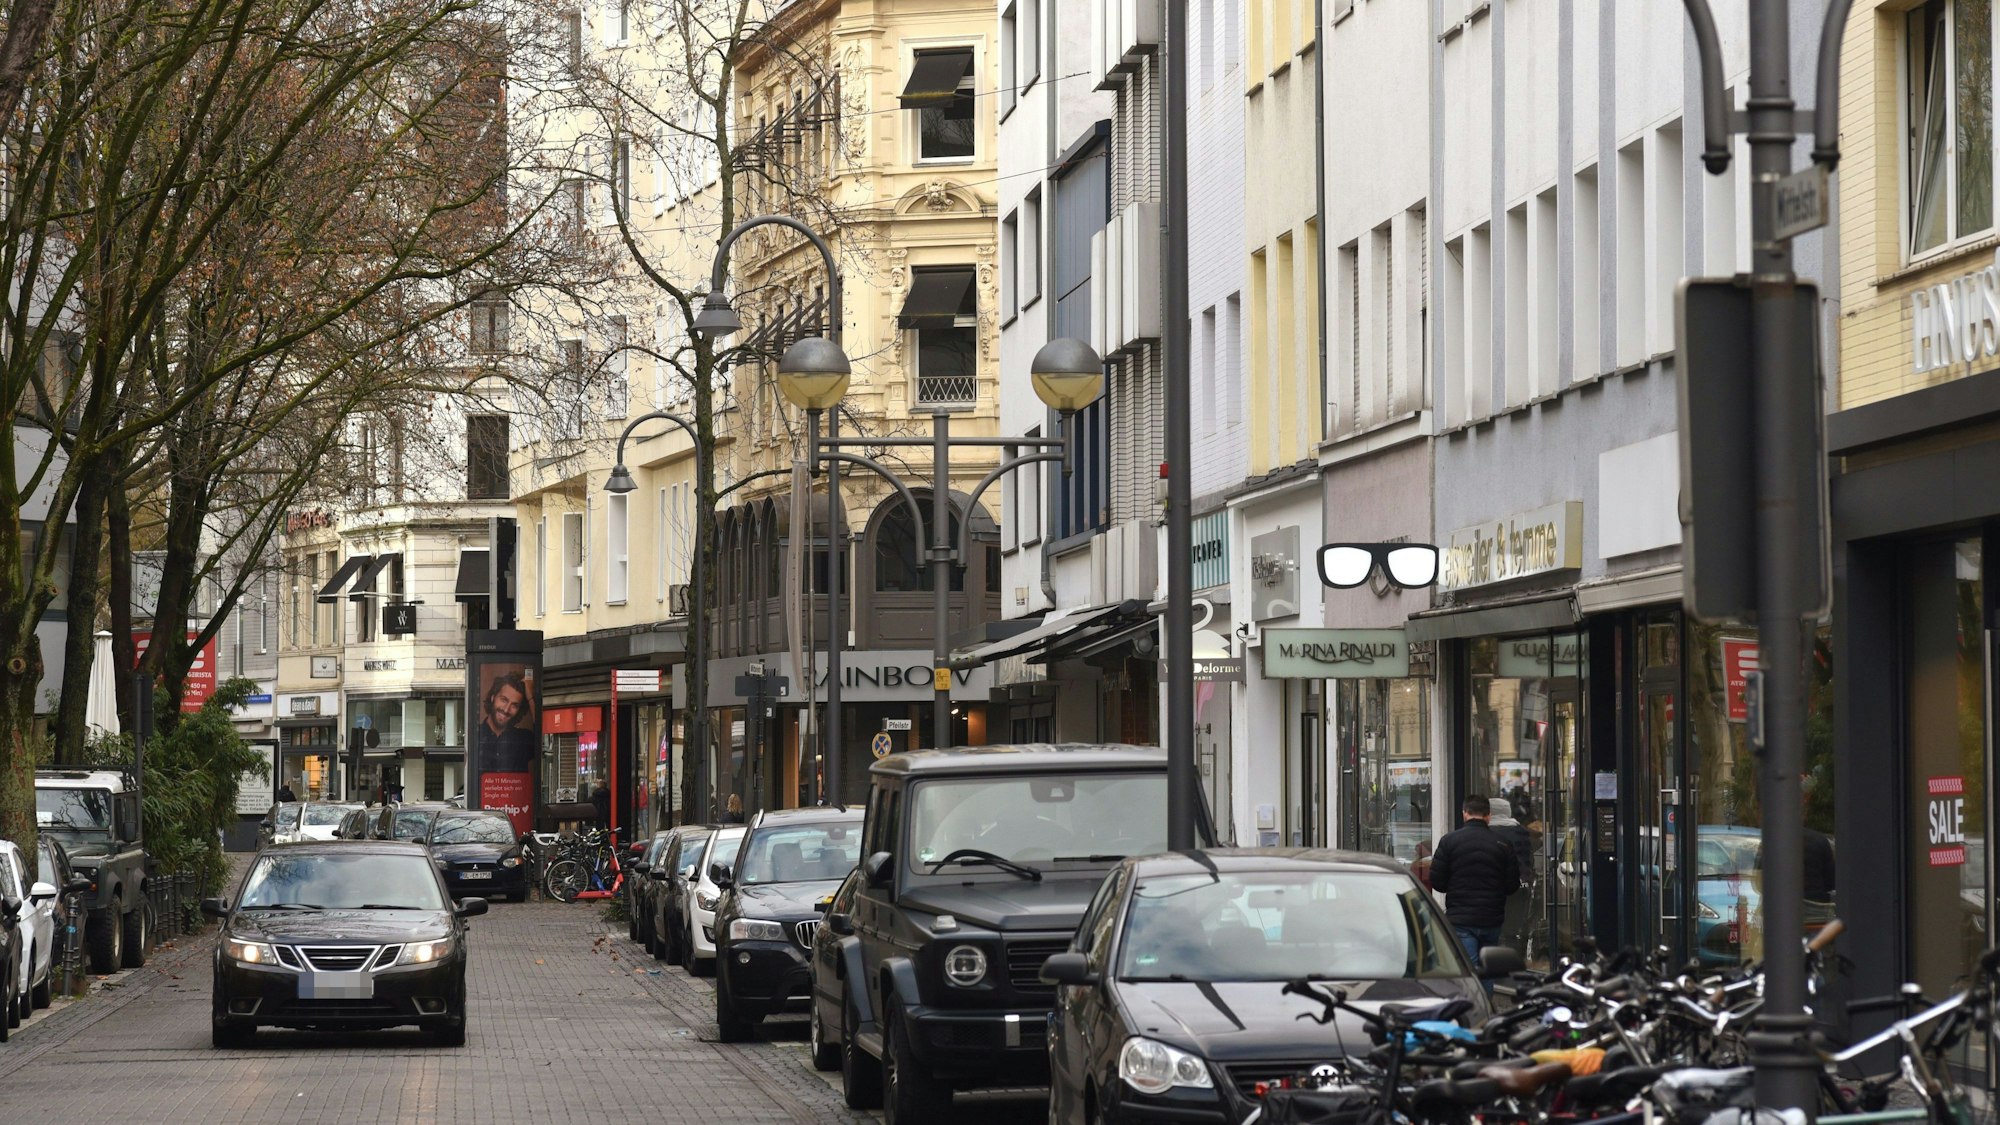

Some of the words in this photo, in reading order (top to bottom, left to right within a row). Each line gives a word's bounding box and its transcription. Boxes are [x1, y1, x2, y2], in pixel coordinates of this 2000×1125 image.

[1496, 522, 1507, 578] &
[1510, 519, 1557, 576] temme
[1279, 643, 1337, 662] MARINA
[1339, 642, 1395, 664] RINALDI
[803, 665, 973, 688] INBOW
[1193, 662, 1241, 674] Delorme
[1928, 798, 1965, 845] SALE
